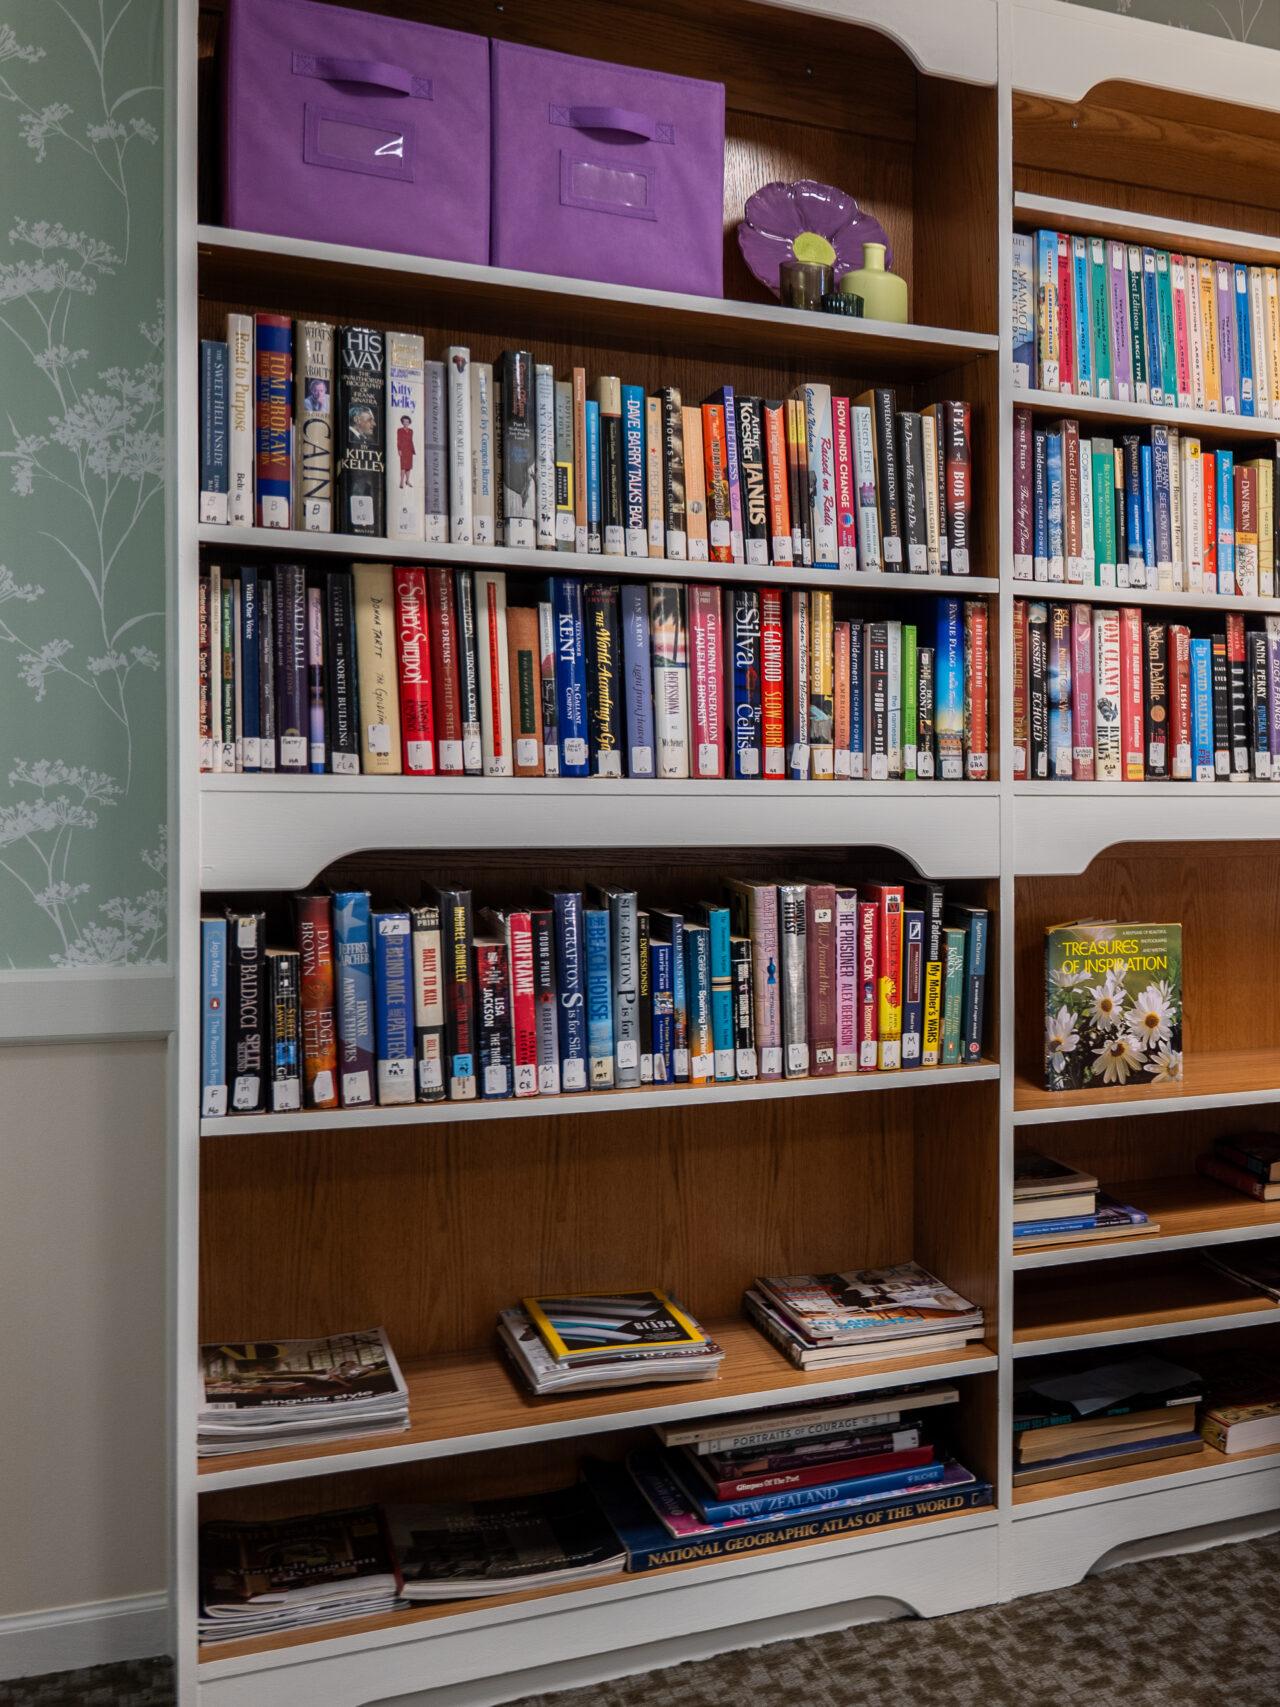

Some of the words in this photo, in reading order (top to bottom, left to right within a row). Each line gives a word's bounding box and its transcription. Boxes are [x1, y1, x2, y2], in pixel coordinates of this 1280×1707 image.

[347, 332, 382, 352] HIS
[270, 354, 286, 389] TOM
[344, 349, 384, 370] WAY
[456, 383, 464, 416] RUNNING
[628, 401, 641, 427] DAVE
[725, 396, 734, 419] FULL
[837, 401, 846, 426] HOW
[270, 396, 286, 467] BROKAW
[727, 421, 735, 440] LIFE
[740, 402, 754, 460] Koestler
[752, 416, 760, 449] Arthur
[883, 394, 893, 449] DEVELOPMENT
[953, 408, 964, 447] FEAR
[346, 449, 383, 461] KITTY
[457, 437, 464, 450] MY
[628, 431, 641, 467] BARRY
[838, 429, 848, 462] MINDS
[887, 451, 893, 461] AS
[1069, 440, 1077, 467] Select
[341, 459, 385, 472] KELLEY
[728, 441, 738, 480] FITNESS
[1036, 435, 1044, 494] Bewilderment
[629, 469, 641, 503] TALKS
[742, 462, 766, 525] JANUS
[841, 465, 849, 508] CHANGE
[887, 463, 895, 500] FREEDOM
[954, 471, 965, 497] BOB
[1069, 468, 1078, 505] Editions
[1242, 480, 1250, 499] DAN
[889, 507, 897, 537] AMARTY
[954, 501, 965, 549] WOODW
[1160, 511, 1168, 531] HOW
[1242, 500, 1251, 530] BROWN
[246, 583, 254, 601] With
[440, 588, 448, 611] DAYS
[246, 602, 254, 618] One
[370, 597, 383, 625] DONNA
[441, 613, 449, 626] OF
[764, 599, 780, 627] JULIE
[948, 603, 958, 636] FANNIE
[246, 619, 254, 639] Voice
[373, 628, 383, 658] TARTT
[559, 613, 575, 664] KENT
[707, 614, 716, 674] CALIFORNIA
[736, 607, 760, 668] Silva
[1104, 616, 1118, 643] TOM
[1149, 625, 1164, 659] Nelson
[443, 629, 451, 663] DRUMS
[764, 631, 782, 682] GARWOOD
[949, 638, 958, 667] FLAGG
[1033, 630, 1042, 678] HOSSEINI
[1256, 639, 1265, 664] ANNE
[574, 683, 581, 692] IN
[1105, 649, 1119, 698] CLANCY
[1150, 662, 1164, 700] DeMille
[1256, 669, 1266, 699] PERRY
[574, 693, 582, 725] GALLANT
[708, 676, 717, 741] GENERATION
[765, 691, 781, 719] SLOW
[1033, 691, 1043, 741] ECHOED
[564, 900, 574, 924] SUE
[863, 907, 875, 929] Mary
[932, 893, 942, 917] Lillian
[454, 907, 465, 941] MICHAEL
[302, 922, 315, 976] BROWN
[317, 930, 330, 967] DALE
[840, 929, 855, 977] PRISONER
[864, 929, 875, 957] Higgins
[929, 920, 942, 960] Faderman
[1063, 940, 1138, 956] TREASURES
[422, 948, 436, 973] RALLY
[455, 944, 467, 983] CONNELLY
[514, 931, 534, 996] AIRFRAME
[565, 927, 577, 989] GRAFTON
[640, 938, 648, 996] EXPRESSIONISM
[864, 958, 875, 980] Clark
[928, 964, 940, 976] My
[947, 947, 956, 977] KARON
[955, 955, 963, 970] JAN
[1063, 960, 1079, 974] OF
[1085, 956, 1167, 974] INSPIRATION
[241, 965, 258, 1028] BALDACCI
[343, 977, 355, 1014] AMONG
[423, 976, 436, 986] TO
[841, 983, 853, 1003] ALEX
[424, 988, 437, 1007] KILL
[483, 987, 494, 1027] JACKSON
[494, 997, 504, 1016] LISA
[562, 992, 584, 1008] S
[928, 979, 939, 1016] Mother's
[320, 1011, 333, 1044] EDGE
[357, 1001, 368, 1036] HONOR
[568, 1009, 577, 1018] is
[569, 1020, 578, 1035] for
[841, 1005, 853, 1046] BERENSON
[304, 1010, 318, 1059] BATTLE
[344, 1015, 357, 1062] THIEVES
[927, 1018, 937, 1043] WARS
[246, 1034, 260, 1070] SPLIT
[261, 1393, 328, 1406] singular
[334, 1389, 373, 1401] style
[733, 1428, 792, 1448] PORTRAITS
[795, 1426, 805, 1436] OF
[808, 1418, 858, 1435] COURAGE
[728, 1502, 763, 1519] NEW
[767, 1487, 839, 1511] ZEALAND
[648, 1541, 722, 1567] NATIONAL
[725, 1522, 818, 1552] GEOGRAPHIC
[820, 1515, 862, 1536] ATLAS
[865, 1511, 884, 1526] OF
[886, 1506, 913, 1521] THE
[915, 1496, 965, 1517] WORLD
